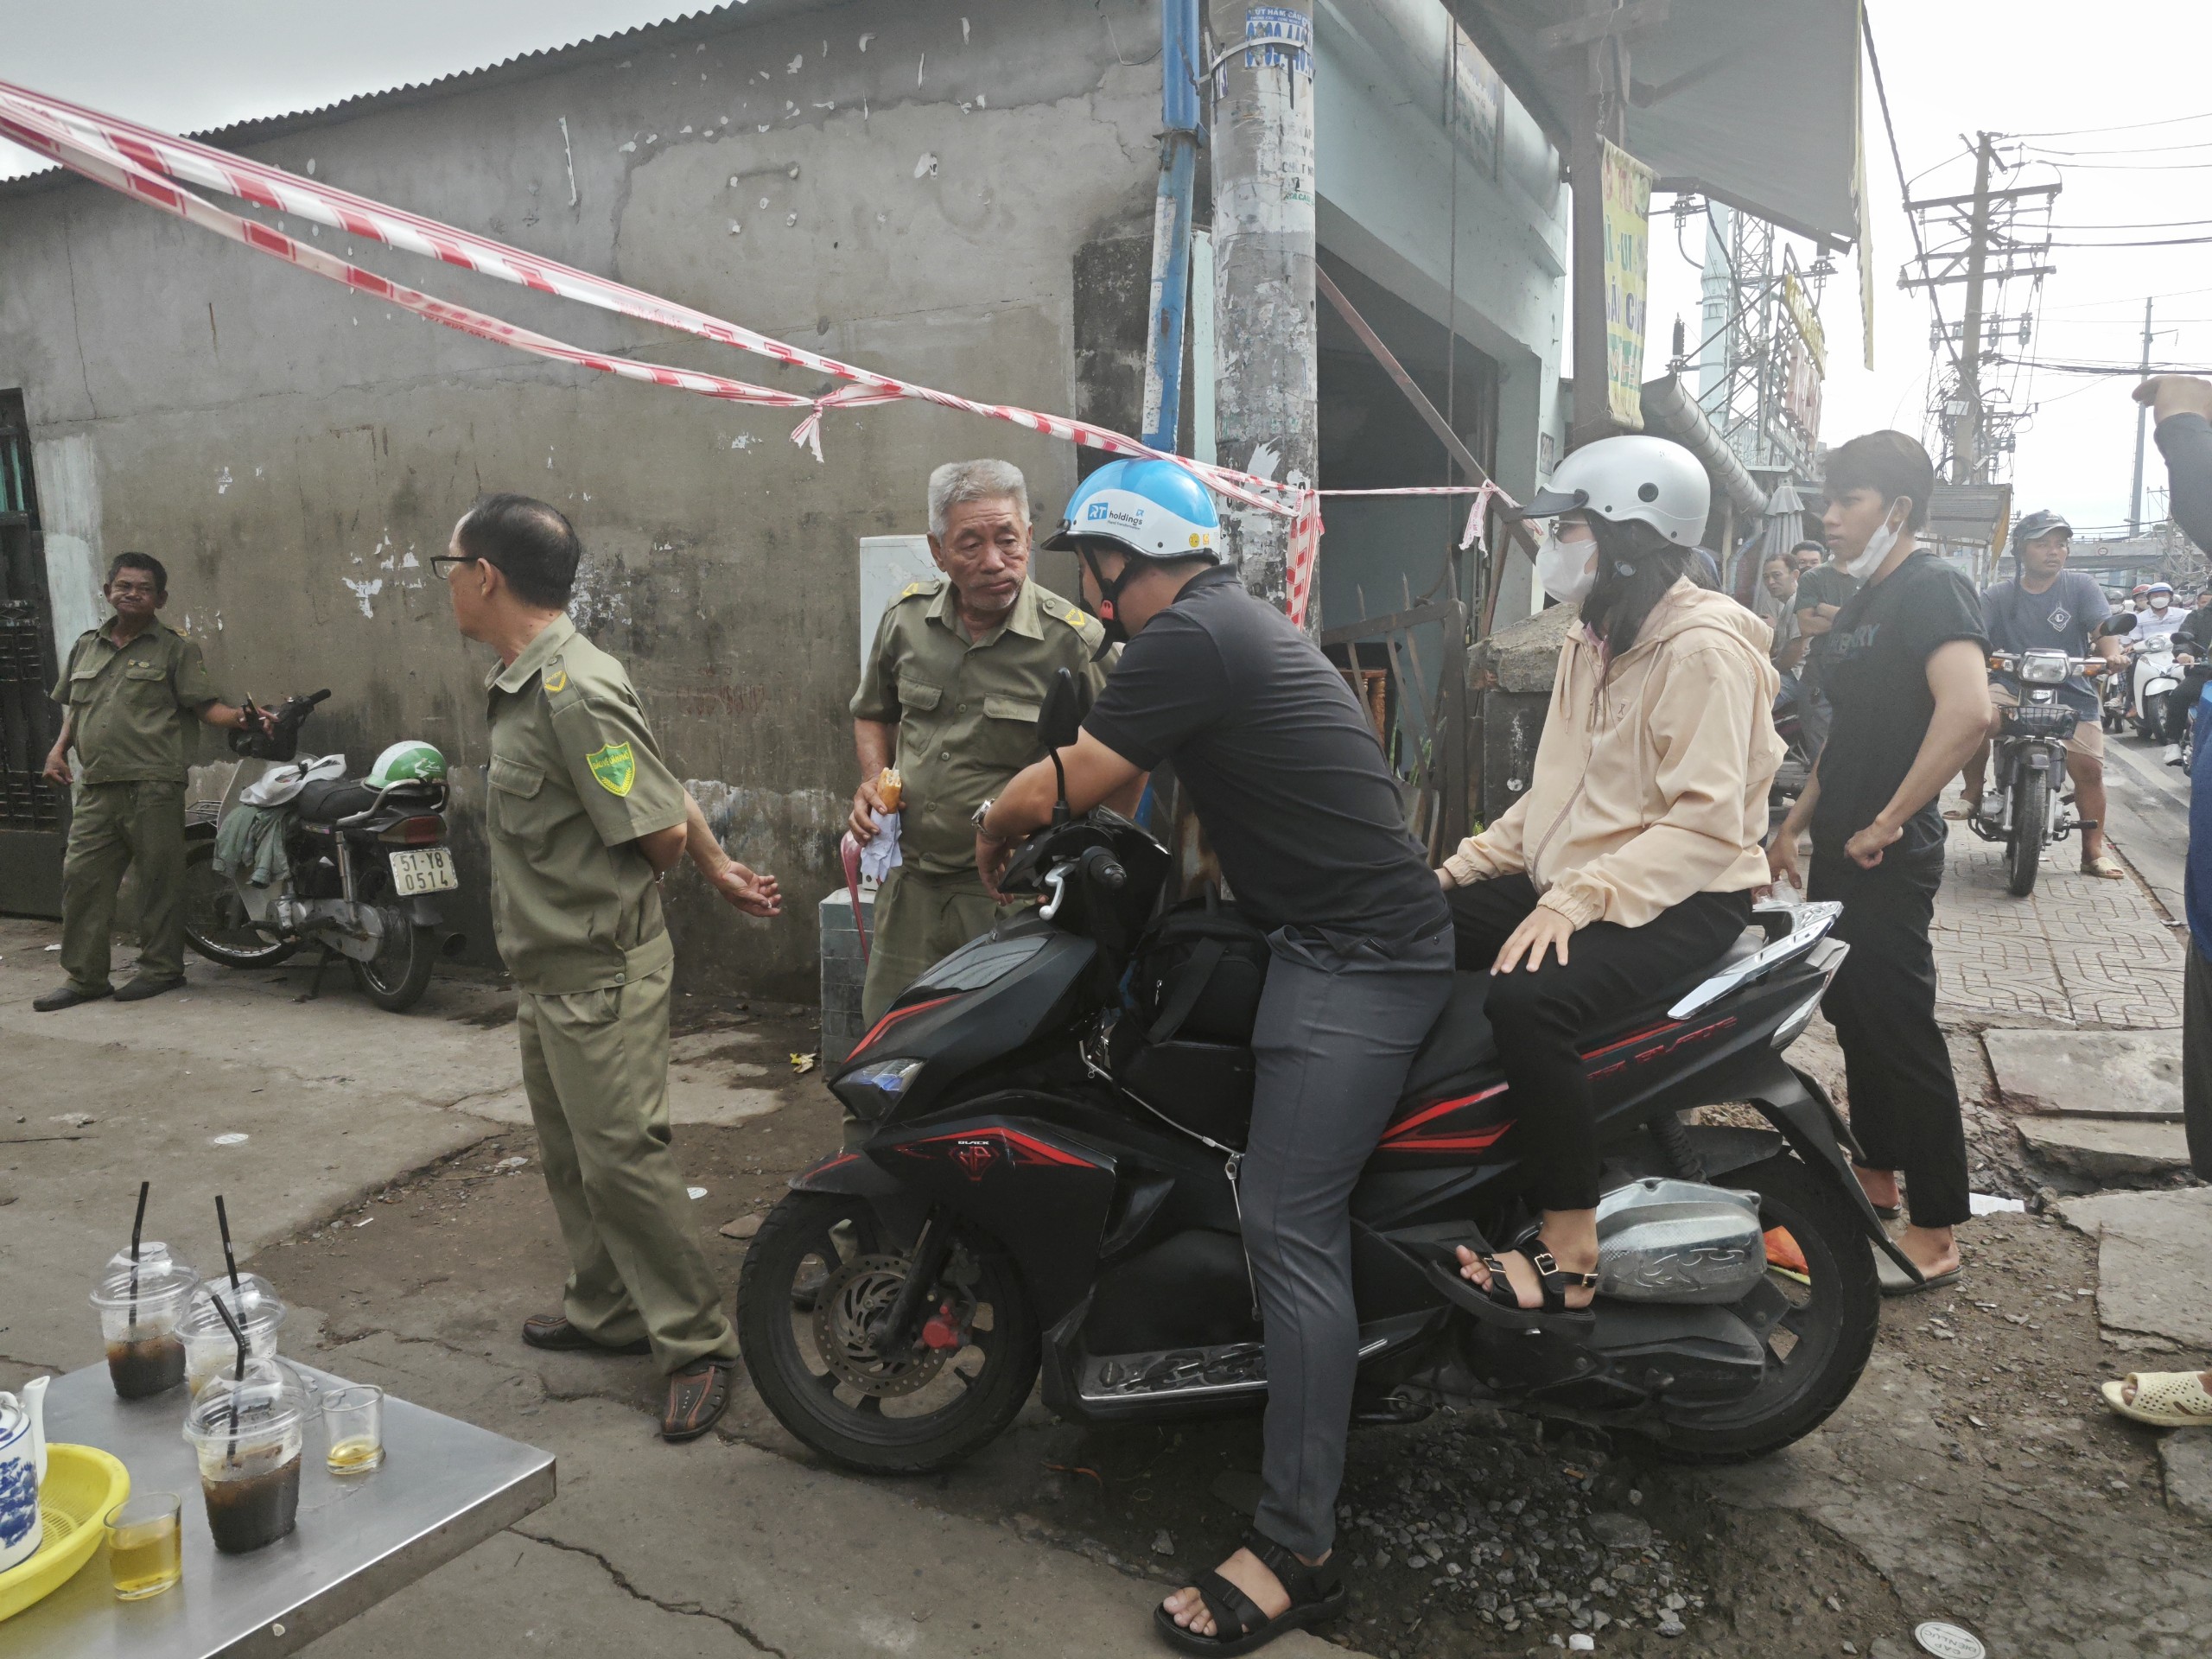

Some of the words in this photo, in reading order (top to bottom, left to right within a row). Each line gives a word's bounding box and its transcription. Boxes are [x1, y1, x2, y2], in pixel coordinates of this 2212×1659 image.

[1109, 510, 1143, 526] holdings
[400, 852, 443, 872] 51-Y8
[405, 870, 448, 890] 0514
